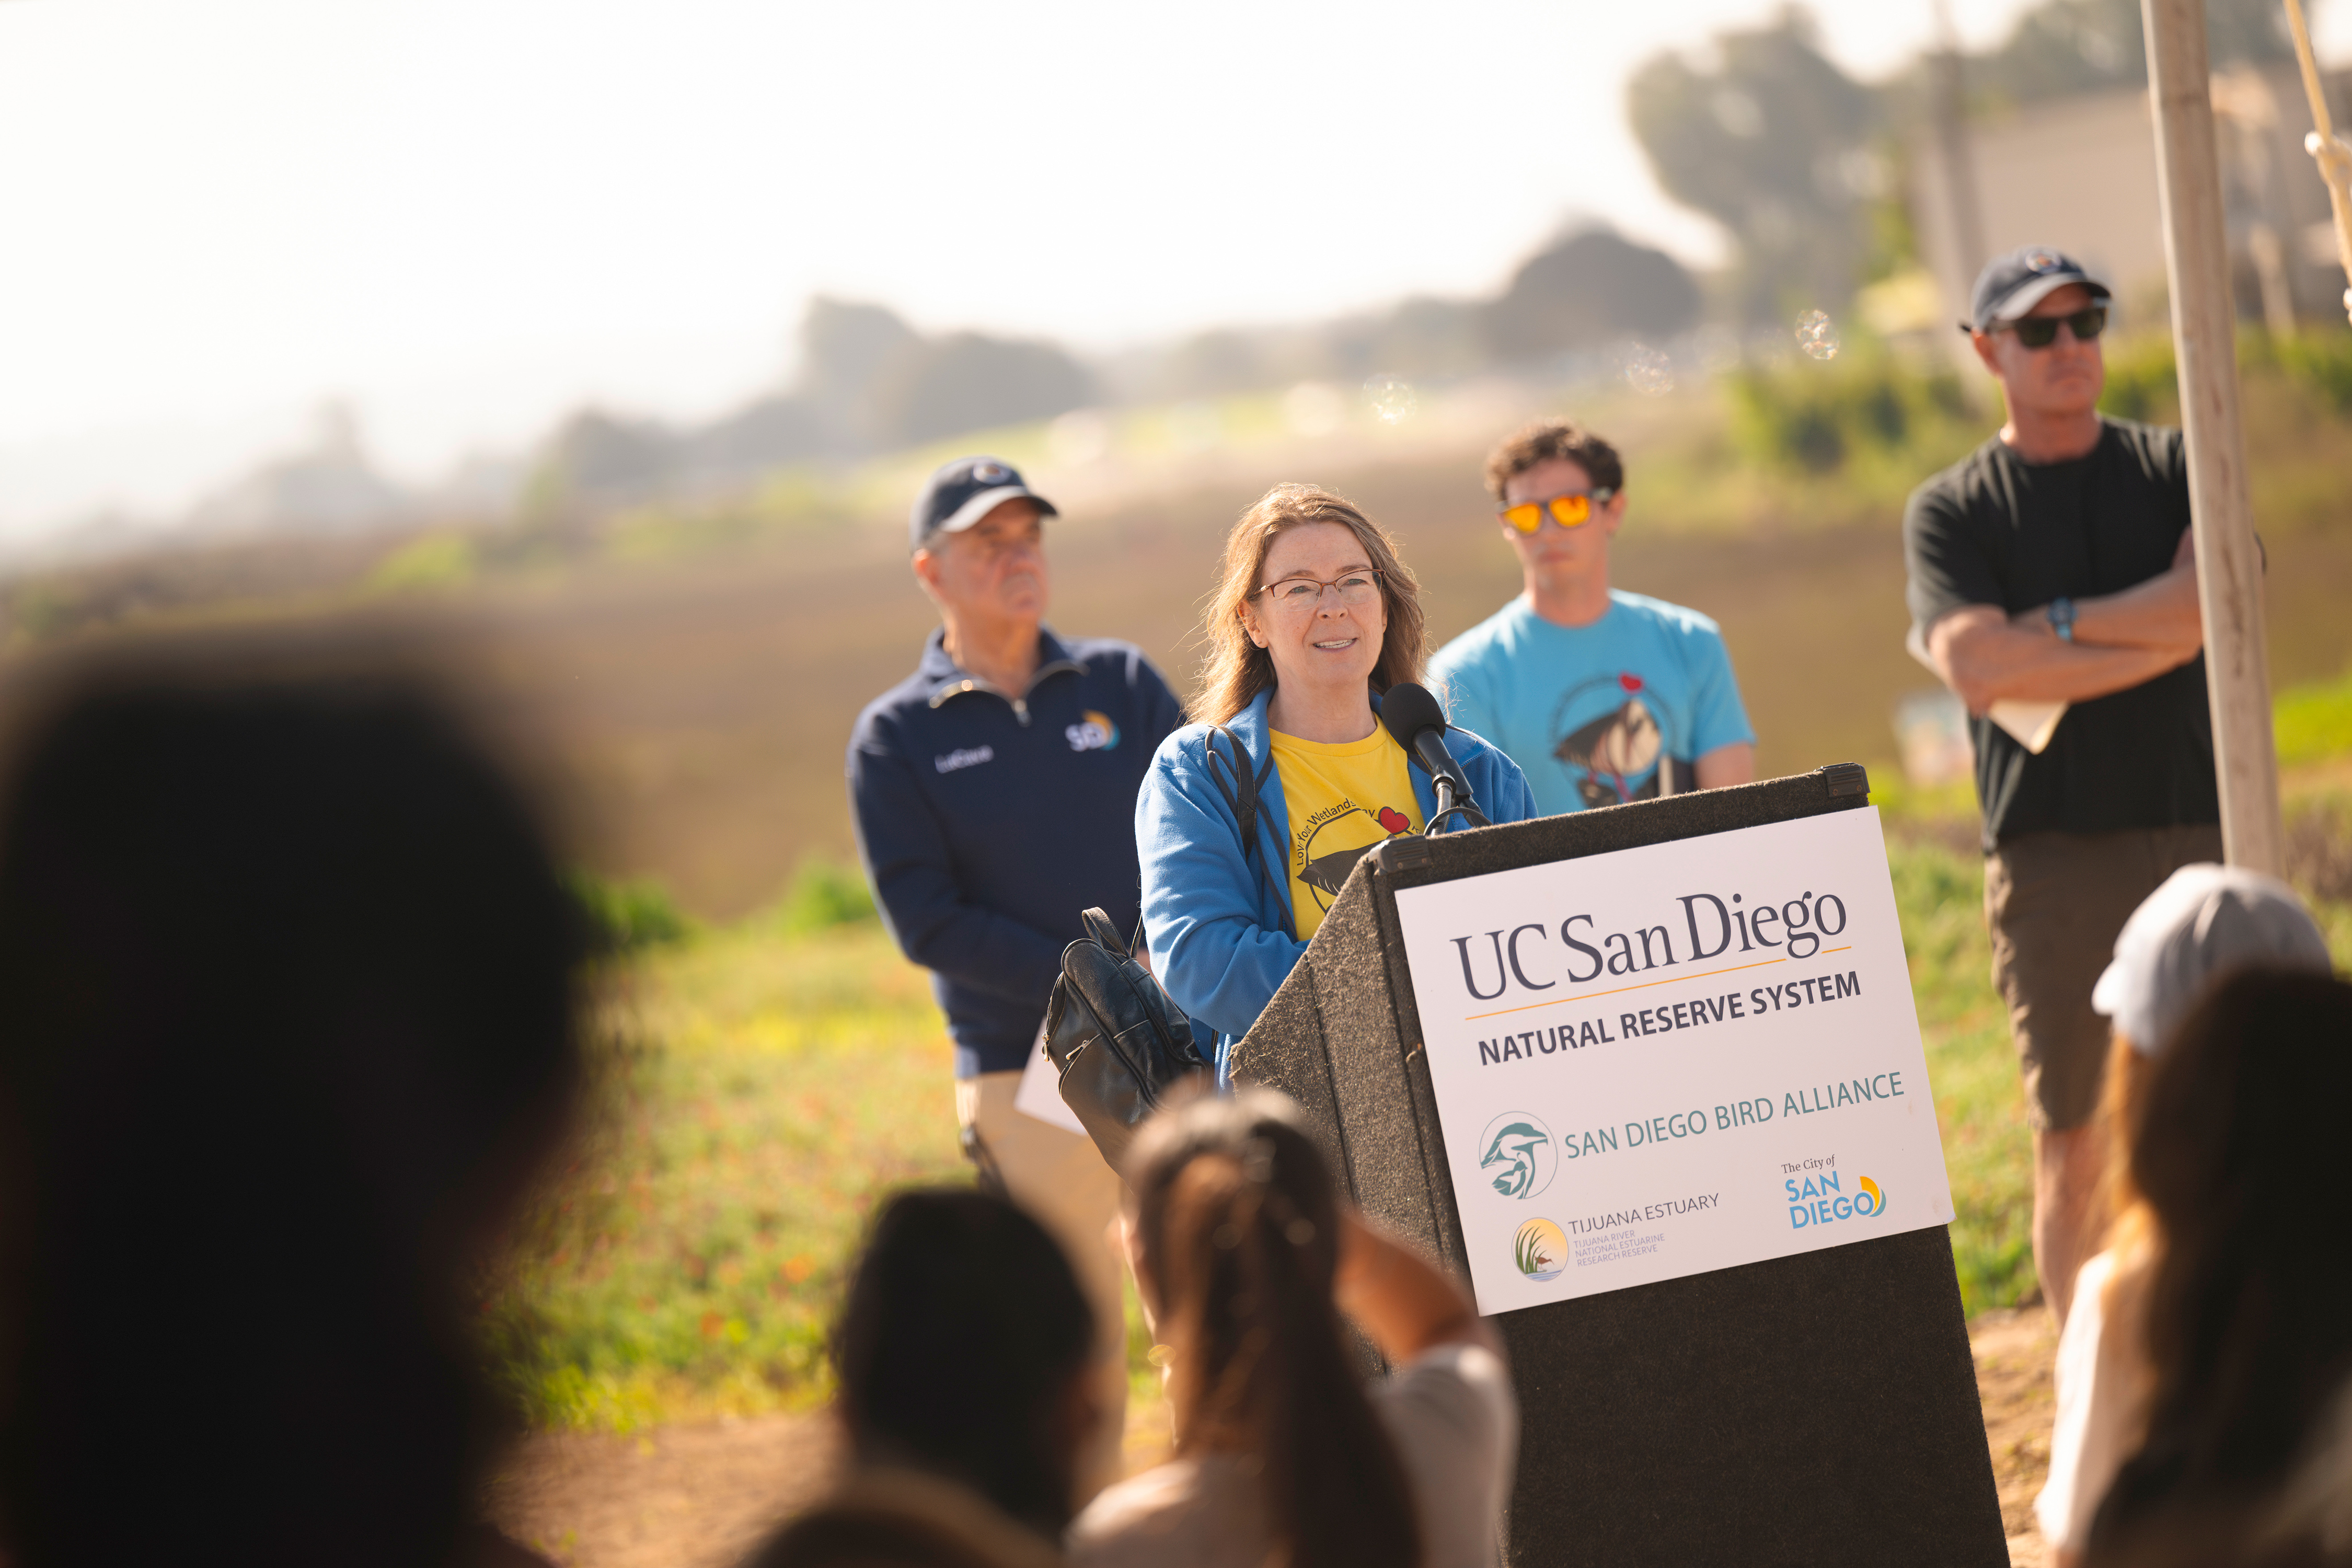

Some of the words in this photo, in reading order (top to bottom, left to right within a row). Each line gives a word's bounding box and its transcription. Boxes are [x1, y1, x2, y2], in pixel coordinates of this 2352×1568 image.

[1297, 825, 1312, 841] Your
[1307, 798, 1356, 825] Wetlands
[1449, 924, 1556, 1000] UC
[1561, 914, 1679, 983] San
[1676, 891, 1847, 960] Diego
[1478, 1019, 1616, 1066] NATURAL
[1620, 993, 1746, 1040] RESERVE
[1750, 971, 1861, 1014] SYSTEM
[1565, 1127, 1618, 1159] SAN
[1625, 1110, 1707, 1147] DIEGO
[1714, 1098, 1773, 1131] BIRD
[1784, 1071, 1905, 1116] ALLIANCE
[1781, 1163, 1801, 1173] The
[1803, 1158, 1824, 1170] City
[1826, 1154, 1836, 1167] of
[1785, 1170, 1841, 1202] SAN
[1568, 1209, 1642, 1235] TIJUANA
[1645, 1193, 1719, 1220] ESTUARY
[1789, 1192, 1874, 1229] DIEGO
[1573, 1235, 1609, 1249] TIJUANA
[1610, 1229, 1635, 1242] RIVER
[1575, 1243, 1618, 1258] NATIONAL
[1619, 1233, 1665, 1250] ESTUARINE
[1577, 1252, 1620, 1267] RESEARCH
[1622, 1244, 1658, 1258] RESERVE
